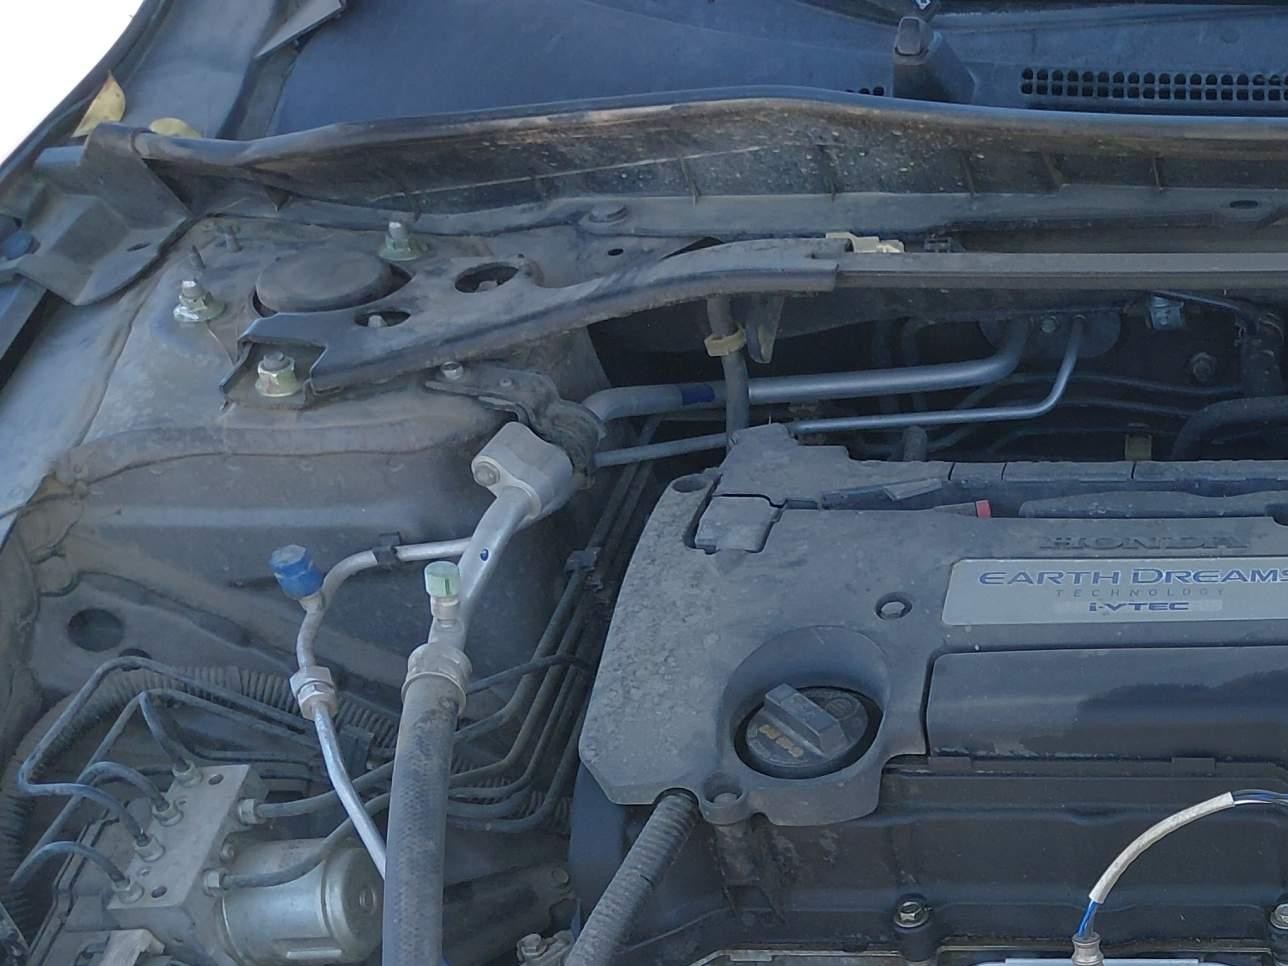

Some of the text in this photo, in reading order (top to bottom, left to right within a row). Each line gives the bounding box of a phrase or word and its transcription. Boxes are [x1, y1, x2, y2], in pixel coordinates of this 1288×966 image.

[1040, 535, 1247, 551] HONDA
[978, 569, 1119, 586] EARTH
[1055, 588, 1226, 599] TECHNOLOGY
